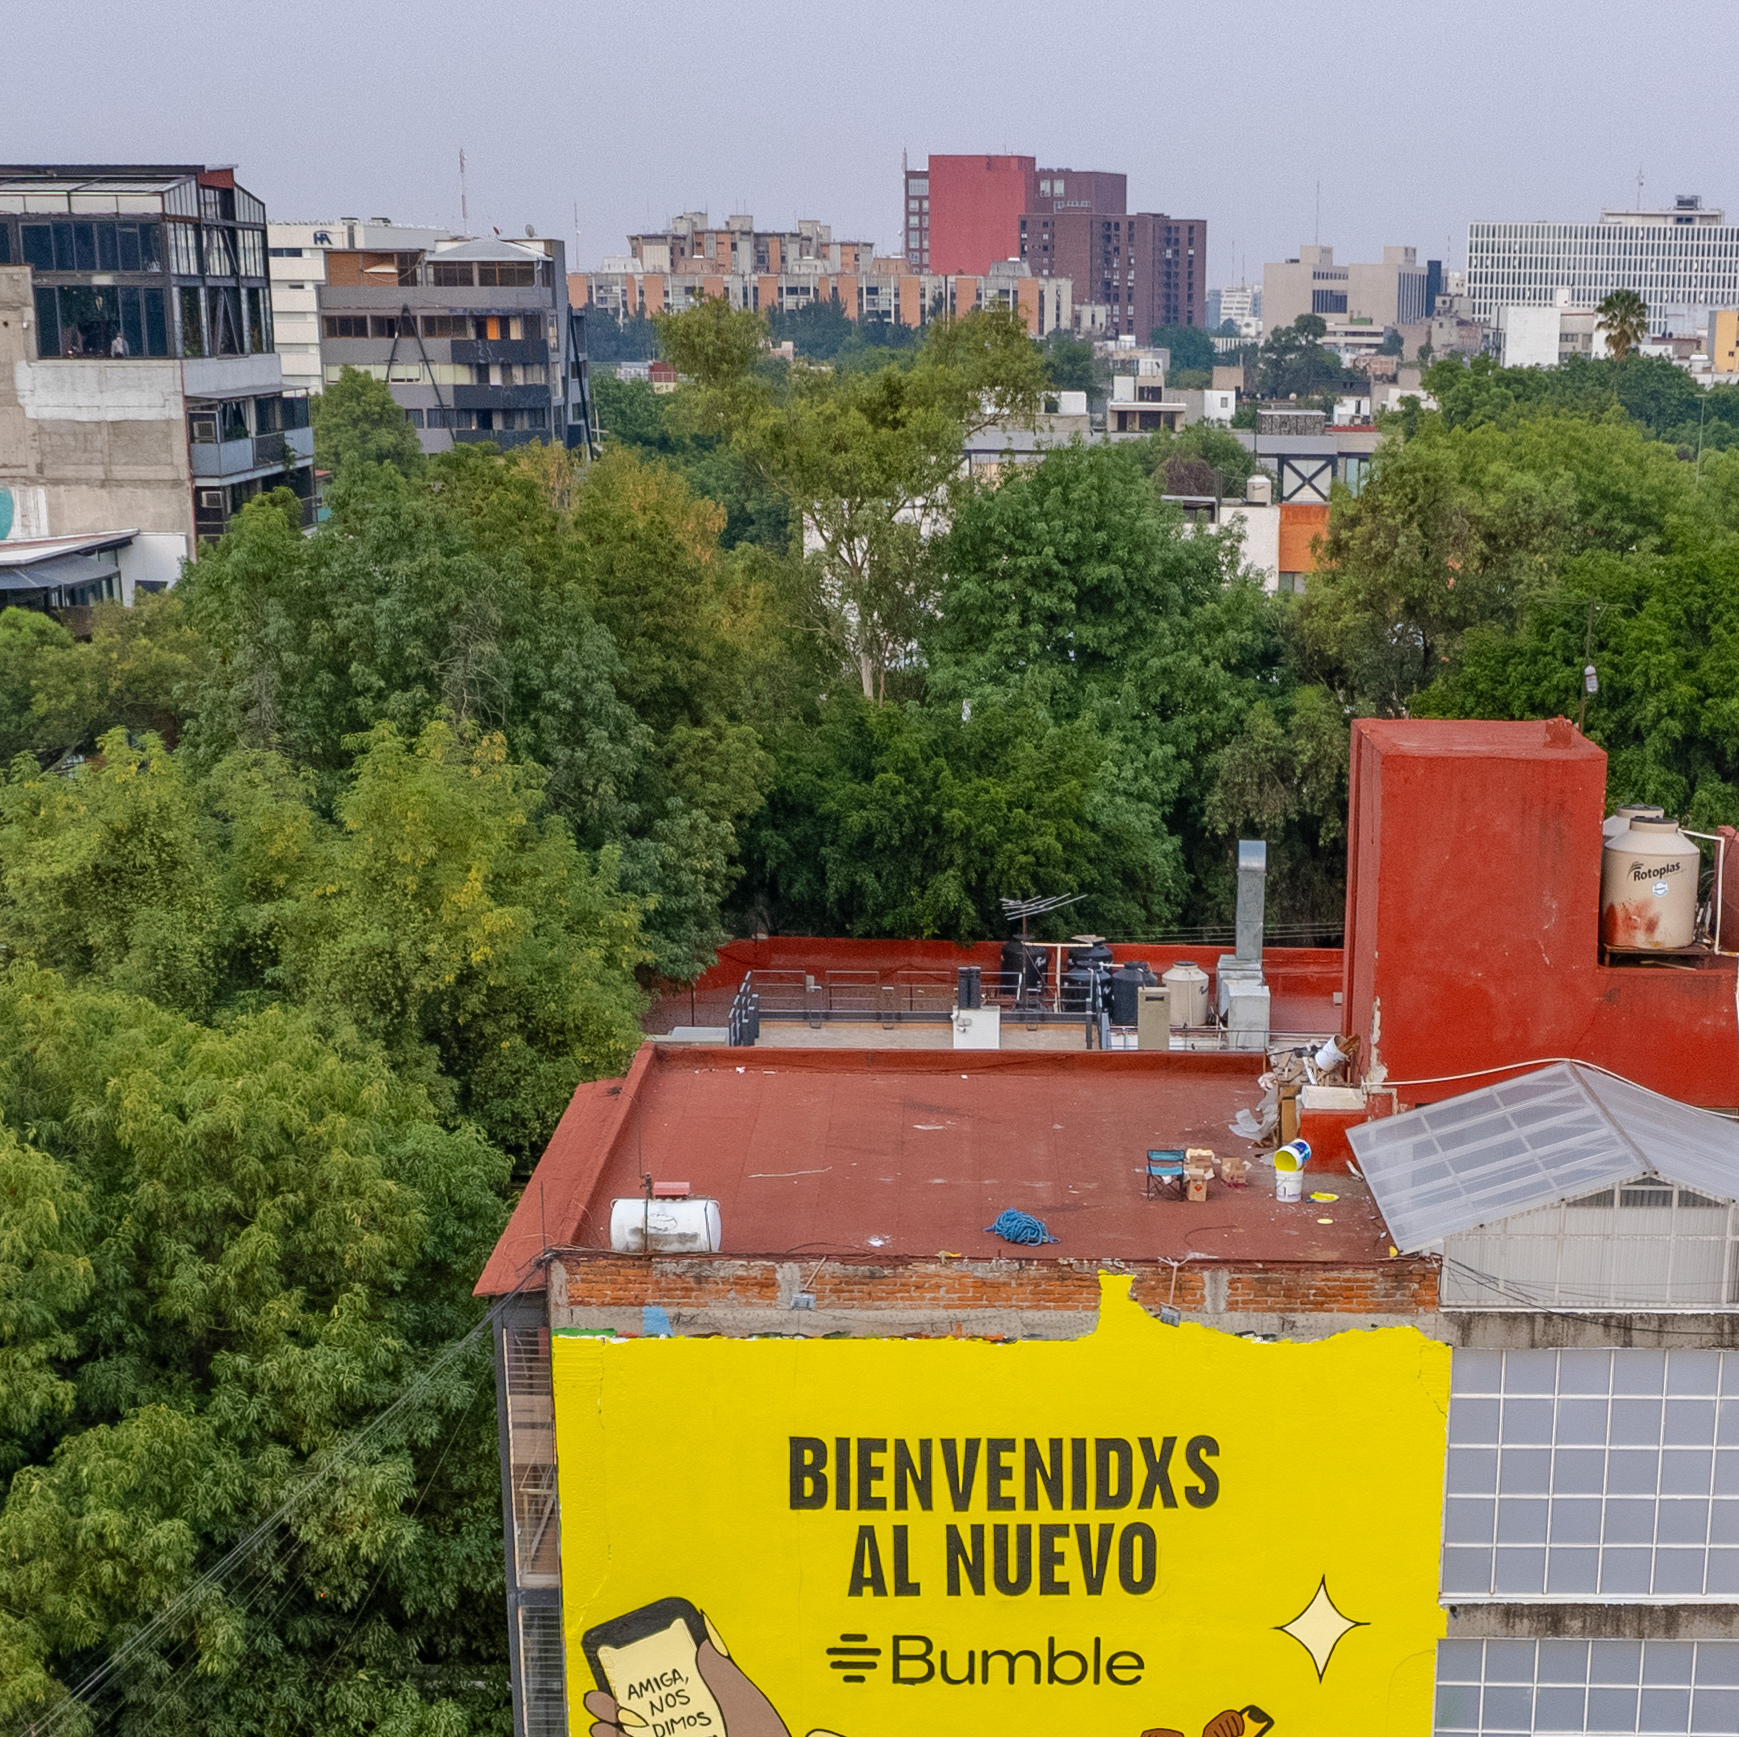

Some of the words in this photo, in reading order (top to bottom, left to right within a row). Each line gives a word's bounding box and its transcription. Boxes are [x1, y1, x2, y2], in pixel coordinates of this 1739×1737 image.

[1633, 862, 1681, 882] Rotoplas
[788, 1434, 1220, 1512] BIENVENIDXS
[847, 1524, 921, 1597] AL
[945, 1521, 1157, 1597] NUEVO
[892, 1634, 1146, 1686] Bumble
[628, 1668, 689, 1701] AMIGA,
[649, 1689, 691, 1717] NOS
